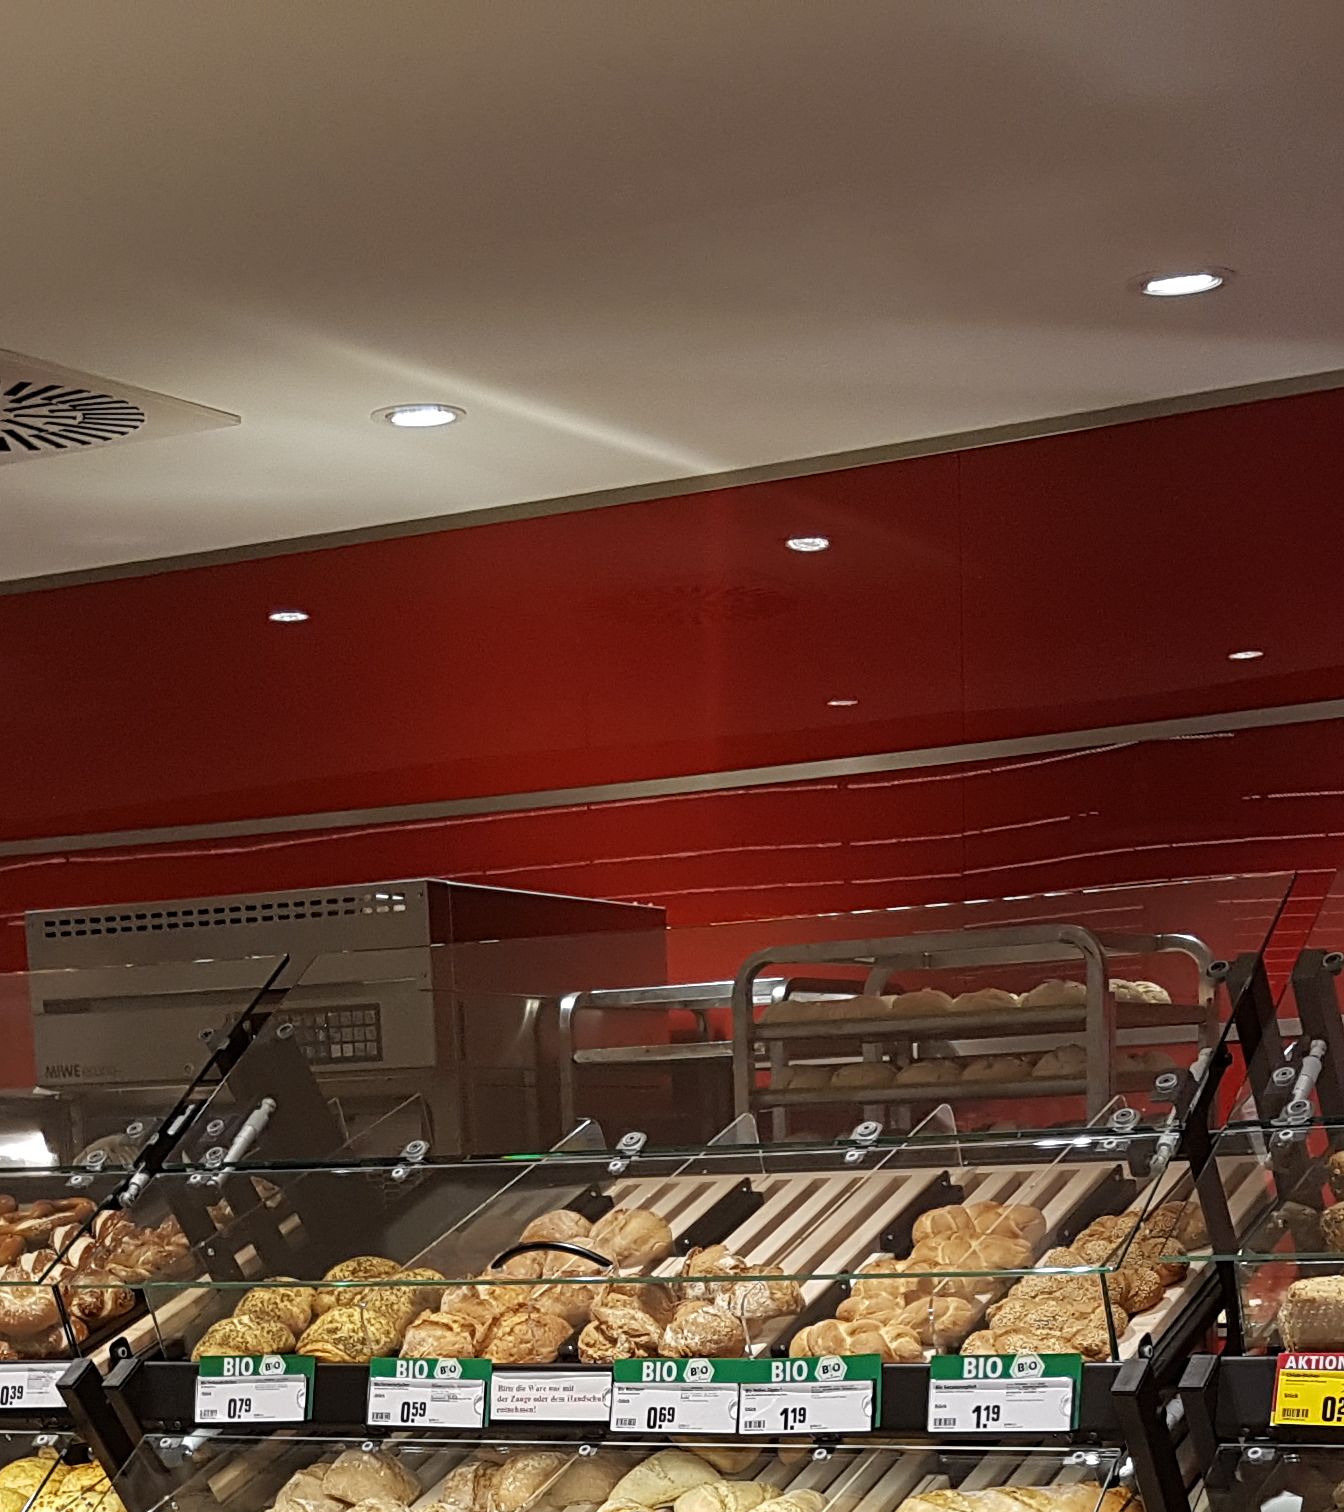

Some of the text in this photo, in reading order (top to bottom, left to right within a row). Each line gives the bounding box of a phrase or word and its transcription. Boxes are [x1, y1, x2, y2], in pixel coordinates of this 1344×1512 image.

[45, 1064, 80, 1079] MIWE
[223, 1357, 254, 1377] BIO
[396, 1360, 429, 1379] BIO
[642, 1361, 678, 1382] BIO
[771, 1361, 808, 1382] BIO
[962, 1357, 1004, 1379] BIO
[972, 1405, 1001, 1429] 1.19
